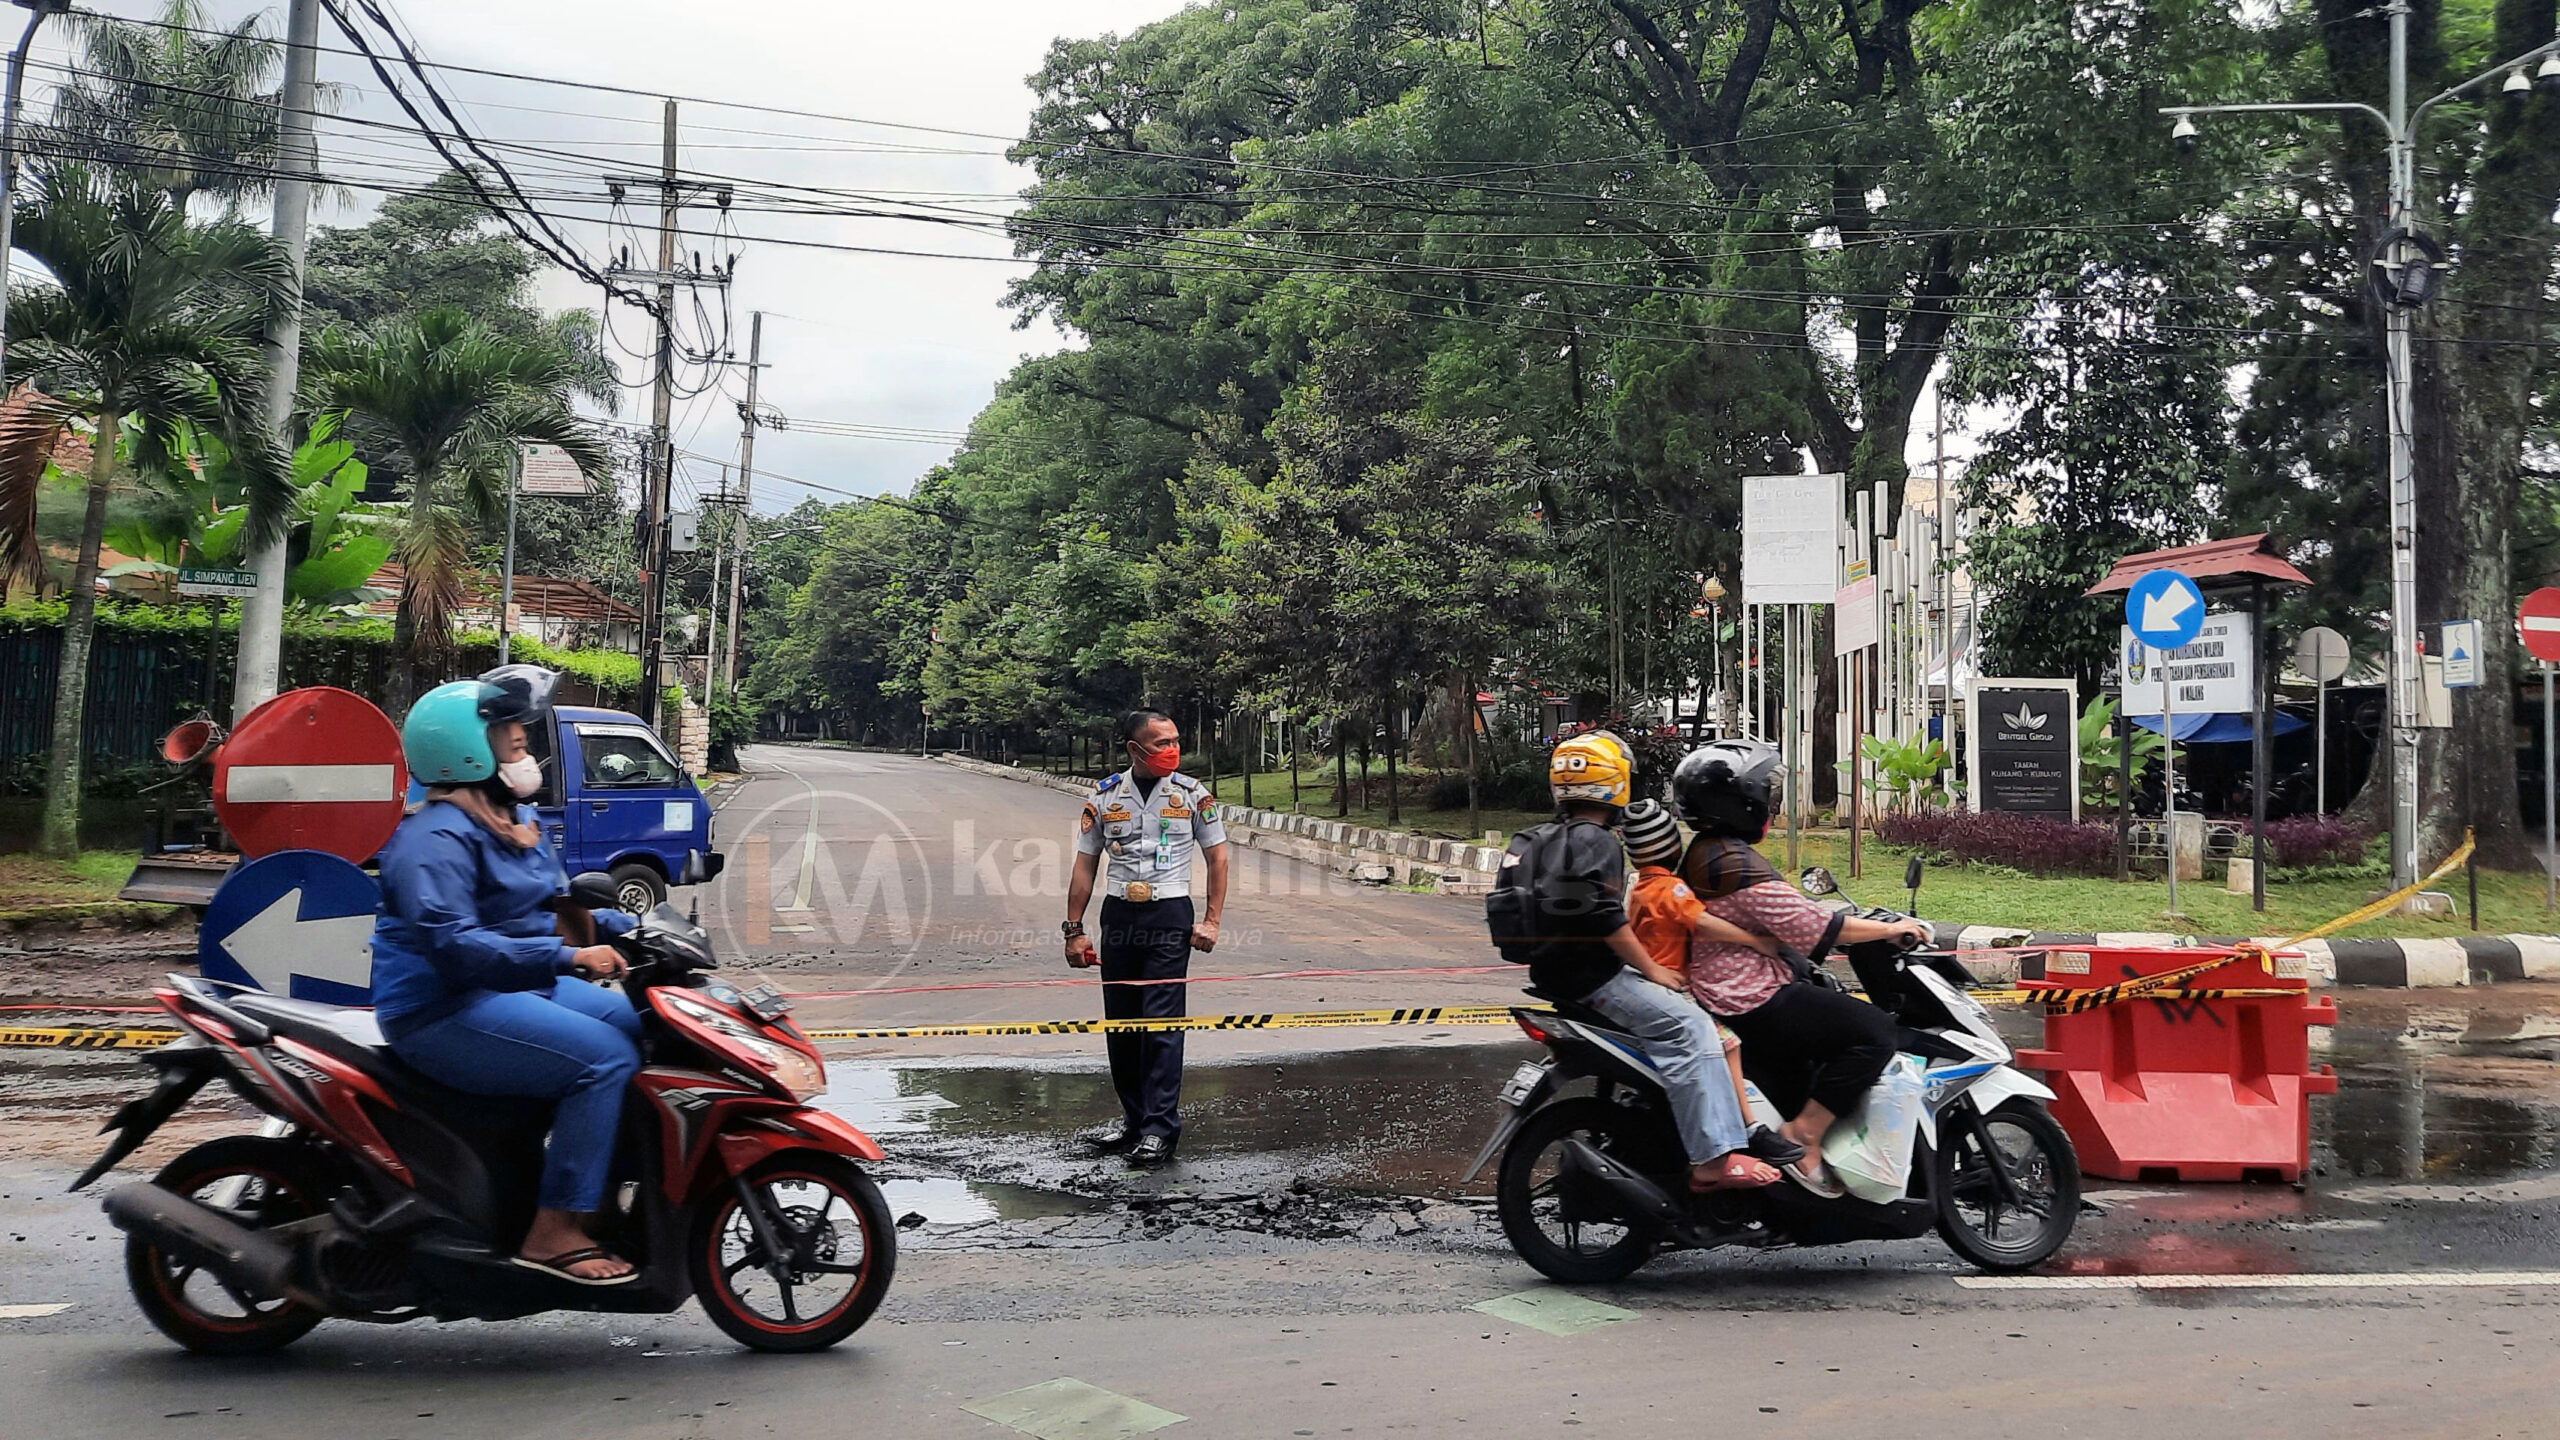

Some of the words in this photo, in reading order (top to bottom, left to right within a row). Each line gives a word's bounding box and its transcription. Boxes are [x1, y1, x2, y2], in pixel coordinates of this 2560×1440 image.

[194, 571, 235, 584] SIMPANG
[2186, 685, 2204, 700] MALANG
[2014, 761, 2039, 769] TAMAN
[1991, 770, 2022, 778] KUNANG
[2030, 770, 2062, 778] KUNANG
